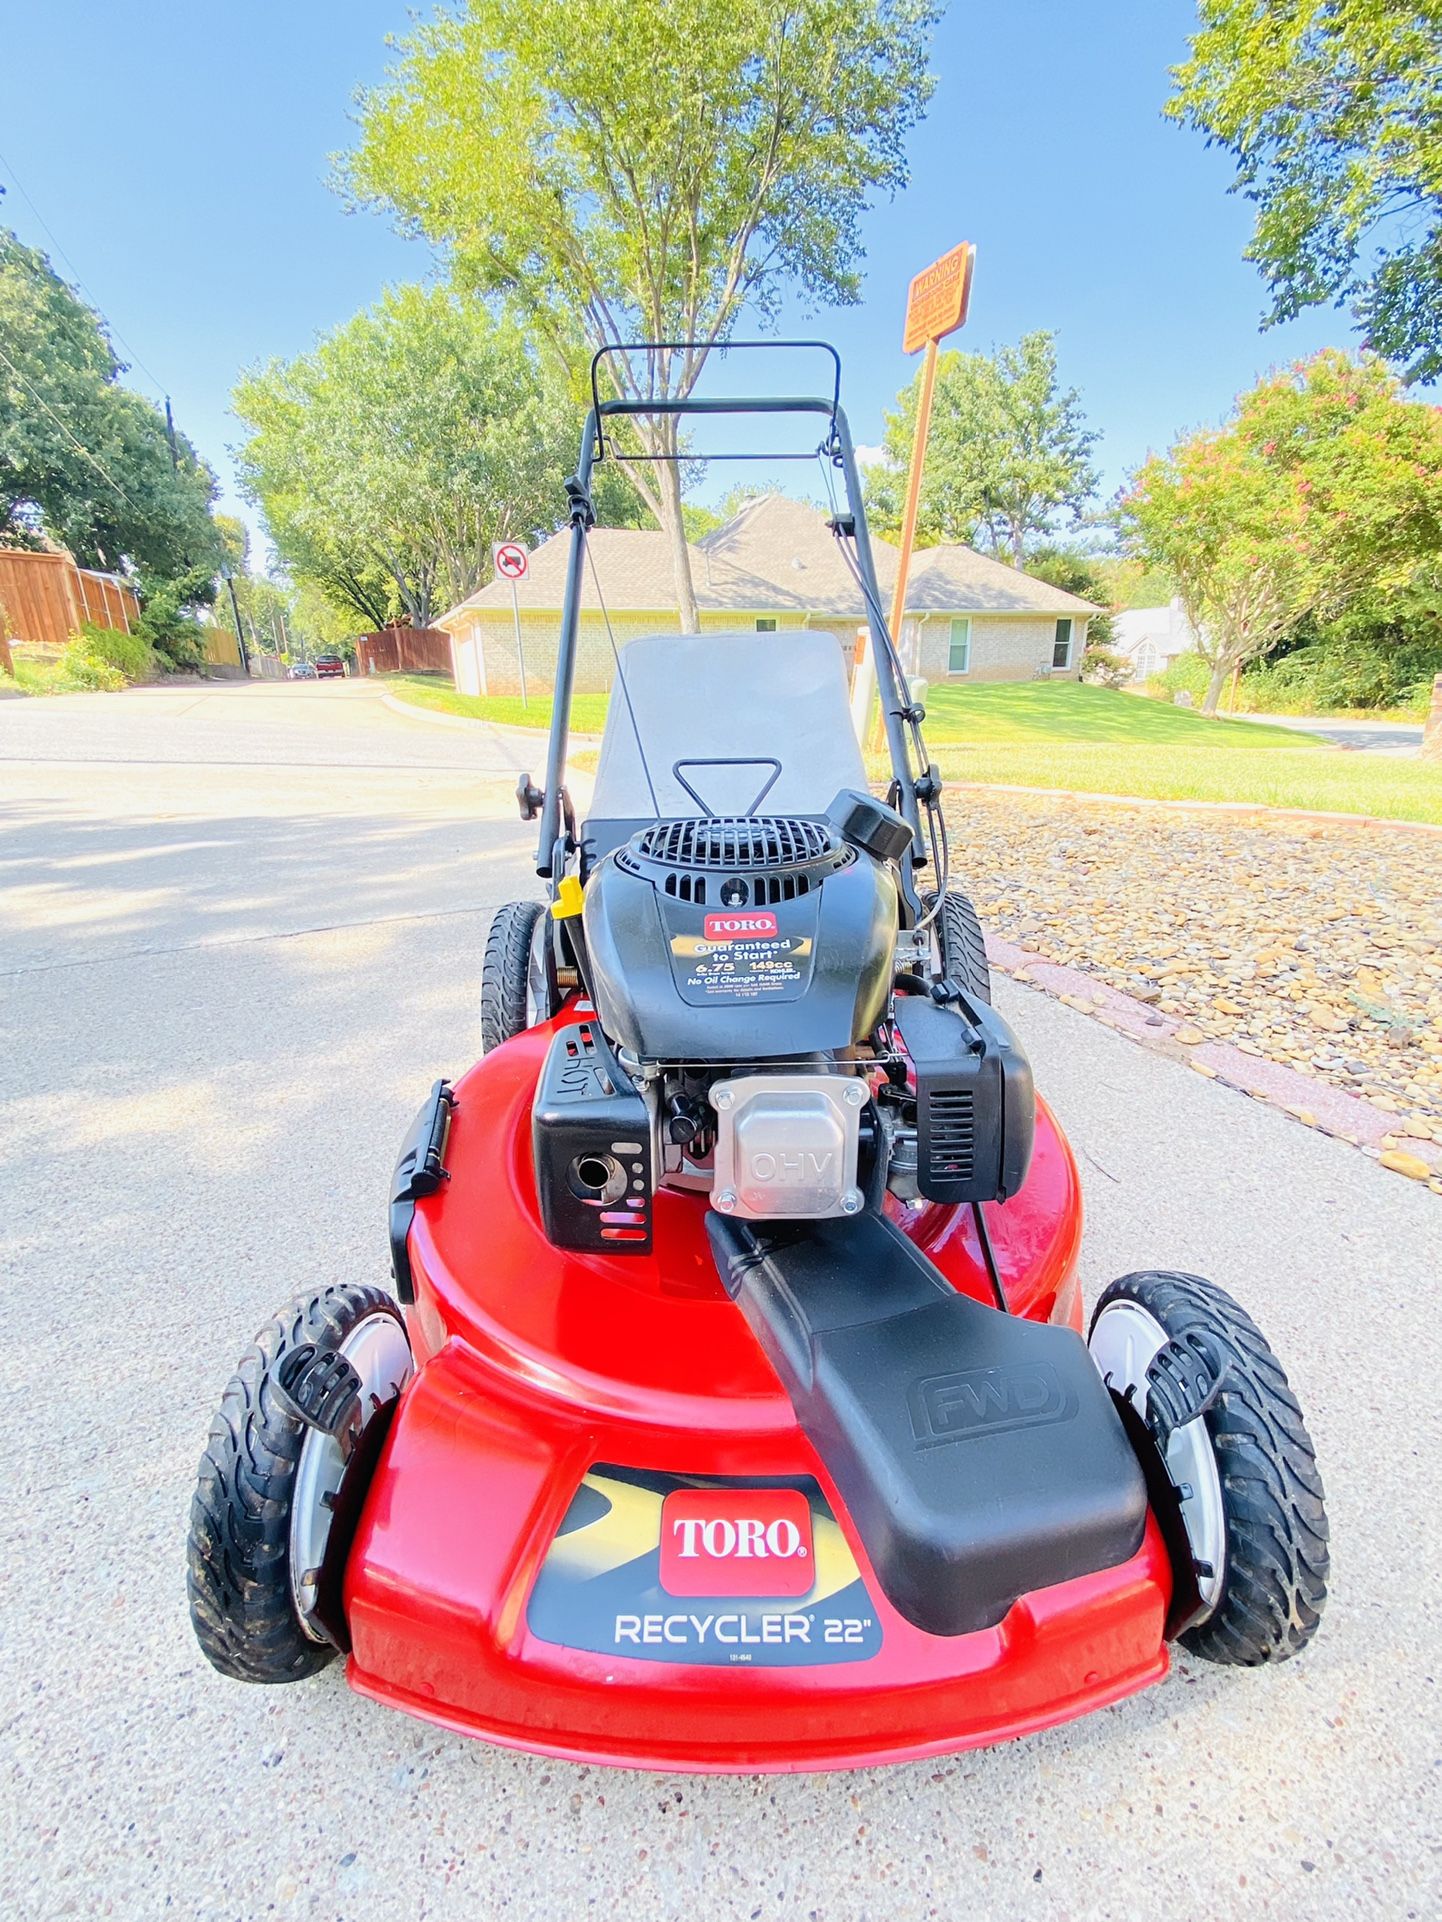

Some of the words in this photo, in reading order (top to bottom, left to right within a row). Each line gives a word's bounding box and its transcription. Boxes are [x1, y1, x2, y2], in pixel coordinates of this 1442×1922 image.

[709, 919, 774, 932] TORO
[695, 939, 790, 953] Guaranteed
[695, 962, 736, 973] 6.75
[749, 961, 793, 970] 149cc
[713, 953, 729, 961] to
[687, 978, 702, 986] No
[704, 976, 718, 985] Oil
[720, 974, 756, 985] Change
[758, 972, 800, 983] Required
[557, 1056, 595, 1095] HOT
[751, 1153, 833, 1182] OHV
[935, 1375, 1050, 1425] FWD
[673, 1519, 800, 1558] TORO
[614, 1615, 811, 1644] RECYCLER
[823, 1618, 871, 1644] 22"
